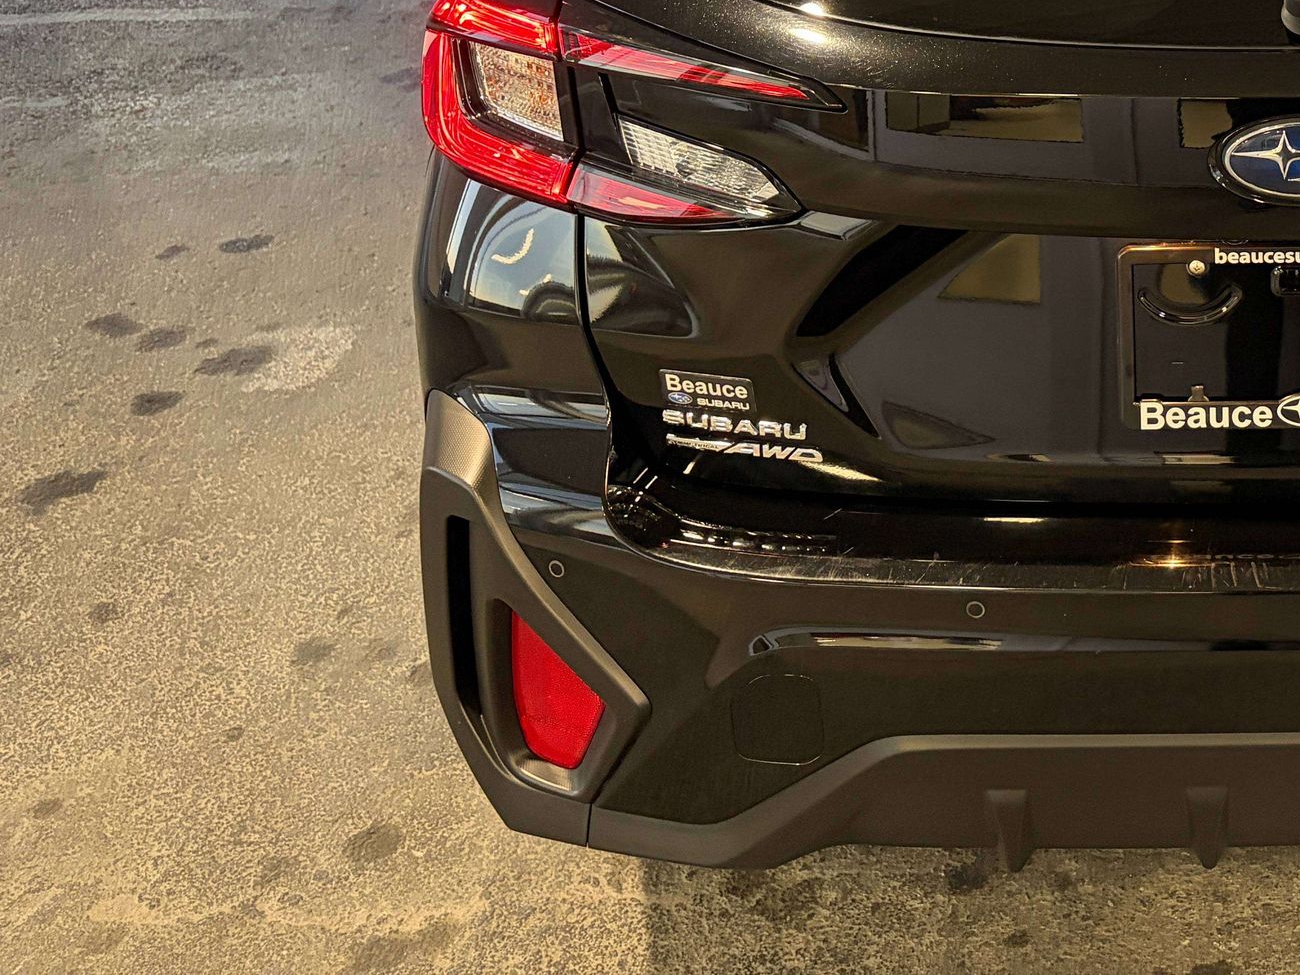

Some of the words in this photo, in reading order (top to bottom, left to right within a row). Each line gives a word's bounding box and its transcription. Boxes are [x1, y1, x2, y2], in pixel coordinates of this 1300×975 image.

[665, 374, 748, 398] Beauce
[697, 398, 750, 410] SUBARU
[1140, 399, 1273, 430] Beauce
[662, 409, 808, 440] SUBARU
[723, 441, 824, 463] AWD
